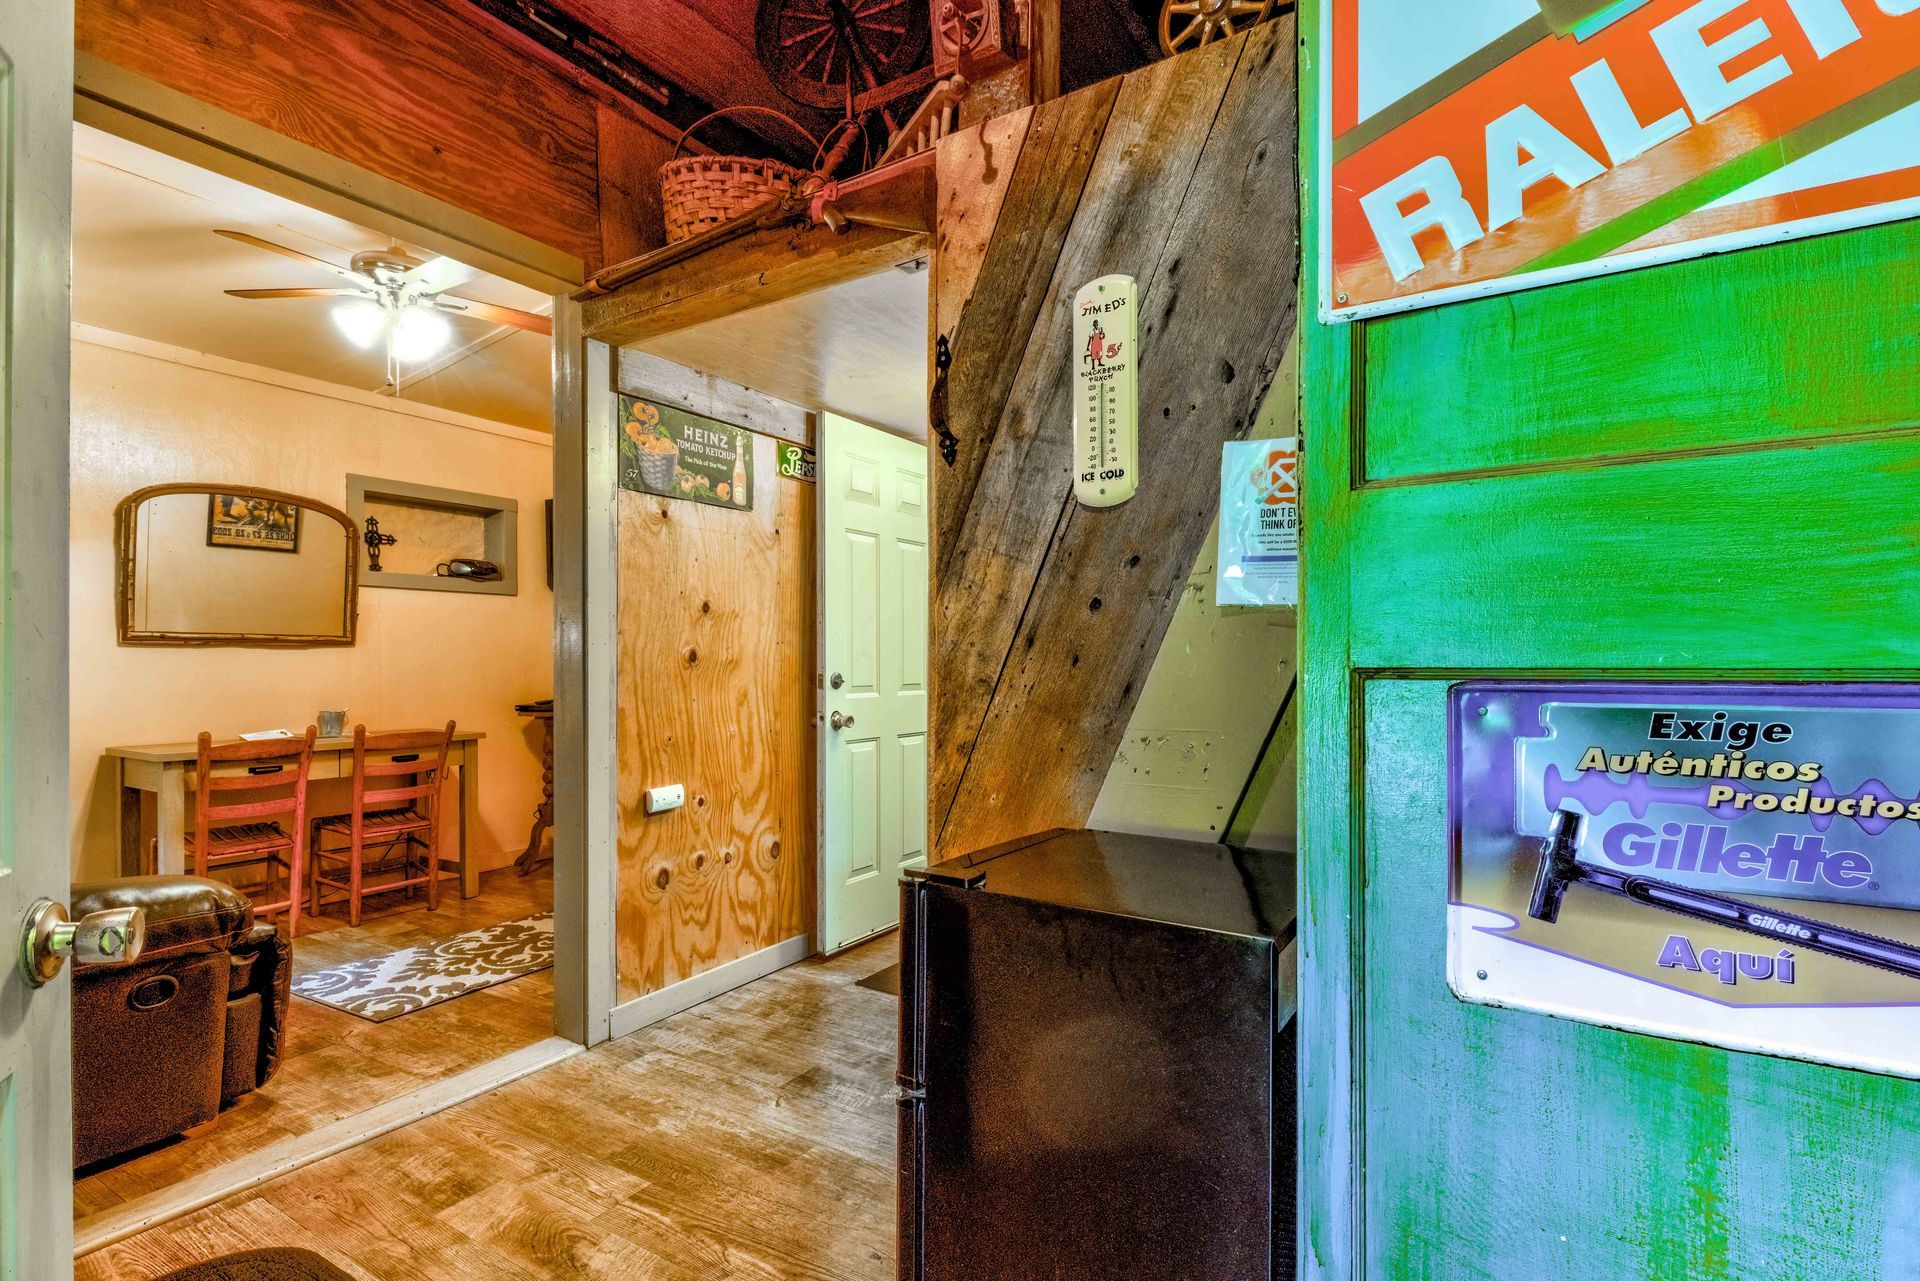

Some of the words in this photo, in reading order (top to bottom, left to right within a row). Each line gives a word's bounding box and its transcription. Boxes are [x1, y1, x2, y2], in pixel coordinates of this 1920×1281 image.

[1359, 0, 1920, 282] RALEI
[1082, 305, 1101, 316] JIM
[1104, 297, 1127, 313] ED'S
[1081, 363, 1125, 377] BLACKBERRY
[1089, 373, 1114, 383] PUNCH
[684, 425, 728, 449] HEINZ
[676, 438, 704, 453] TOMATO
[705, 446, 736, 461] KETCHUP
[625, 467, 638, 479] 57
[1081, 472, 1095, 482] ICE
[1100, 469, 1124, 480] COLD
[1260, 508, 1286, 518] DON'T
[1261, 519, 1285, 529] THINK
[1648, 711, 1793, 750] Exige
[1576, 747, 1823, 783] Auténticos
[1706, 784, 1920, 821] Productos
[1602, 821, 1874, 889] Gillette
[1747, 912, 1813, 941] Gillette
[1655, 933, 1796, 984] Aquí
